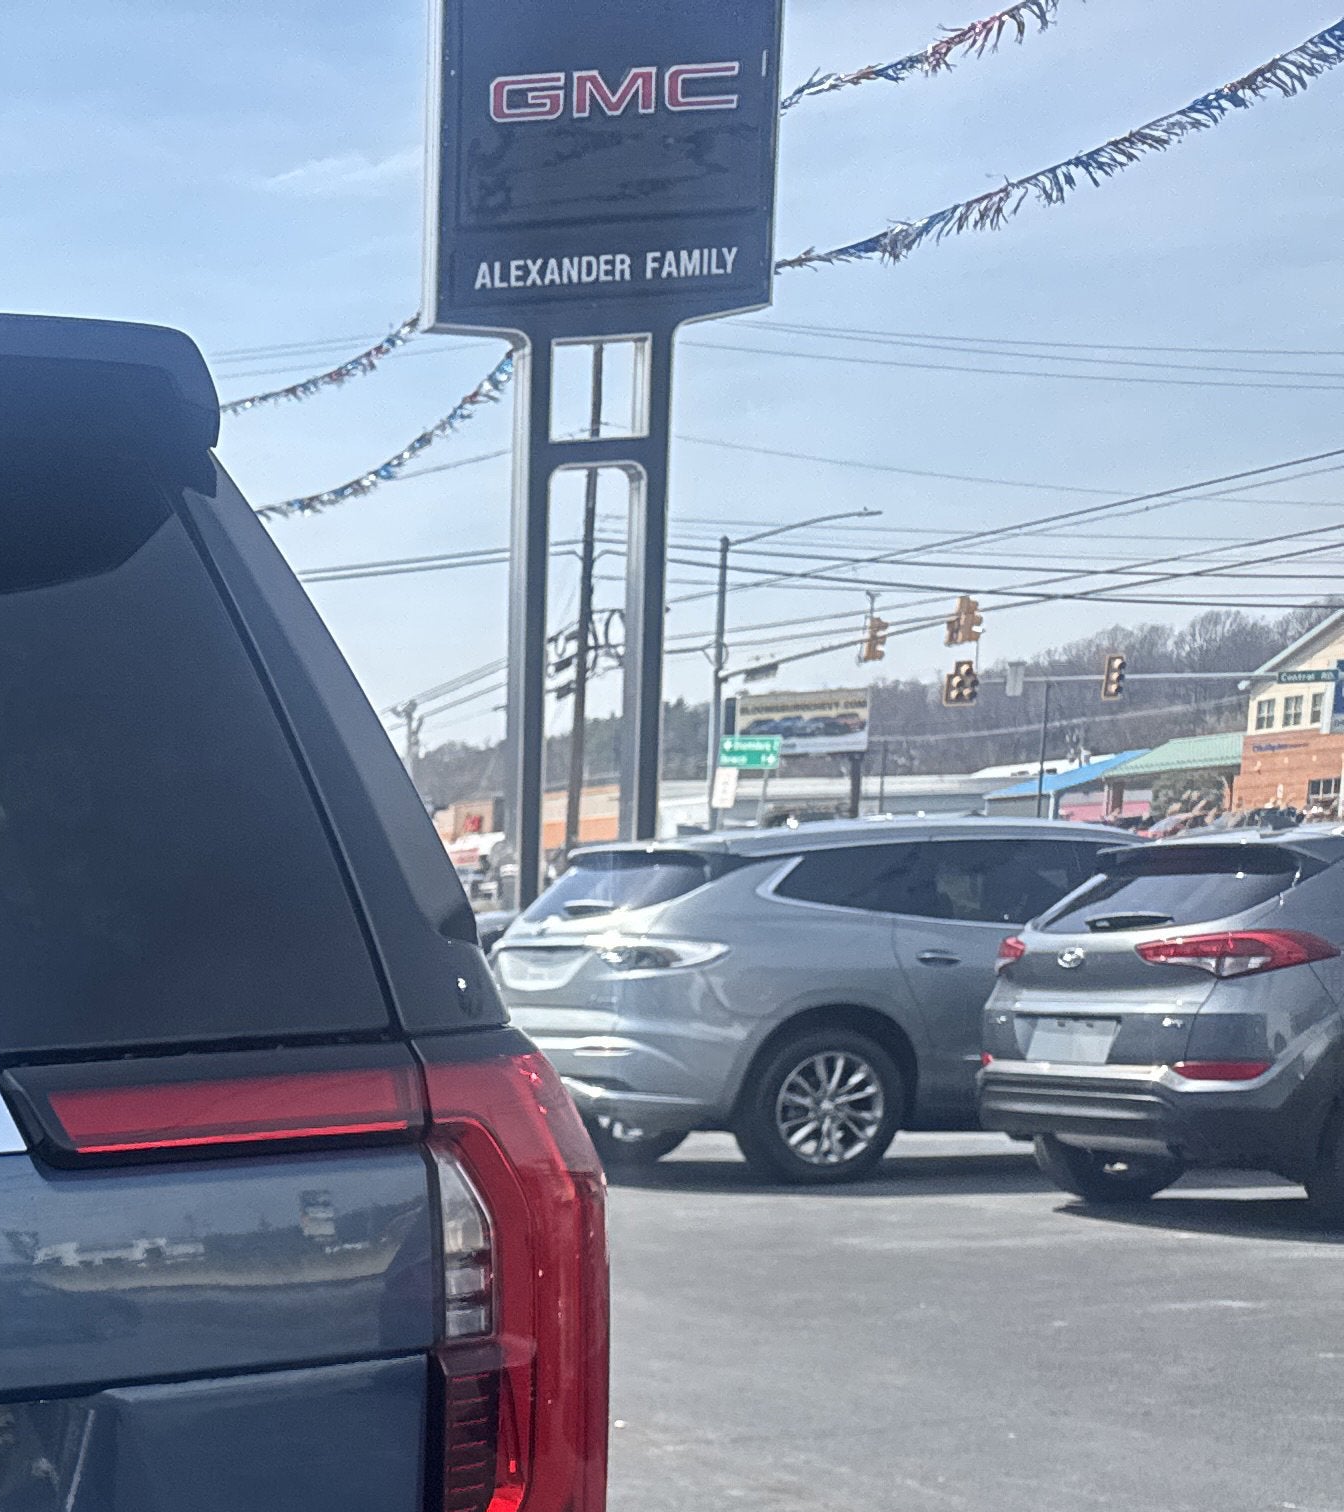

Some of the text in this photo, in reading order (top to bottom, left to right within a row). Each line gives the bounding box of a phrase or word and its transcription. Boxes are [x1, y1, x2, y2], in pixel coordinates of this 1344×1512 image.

[489, 61, 740, 123] GMC
[474, 247, 739, 290] ALEXANDER FAMILY
